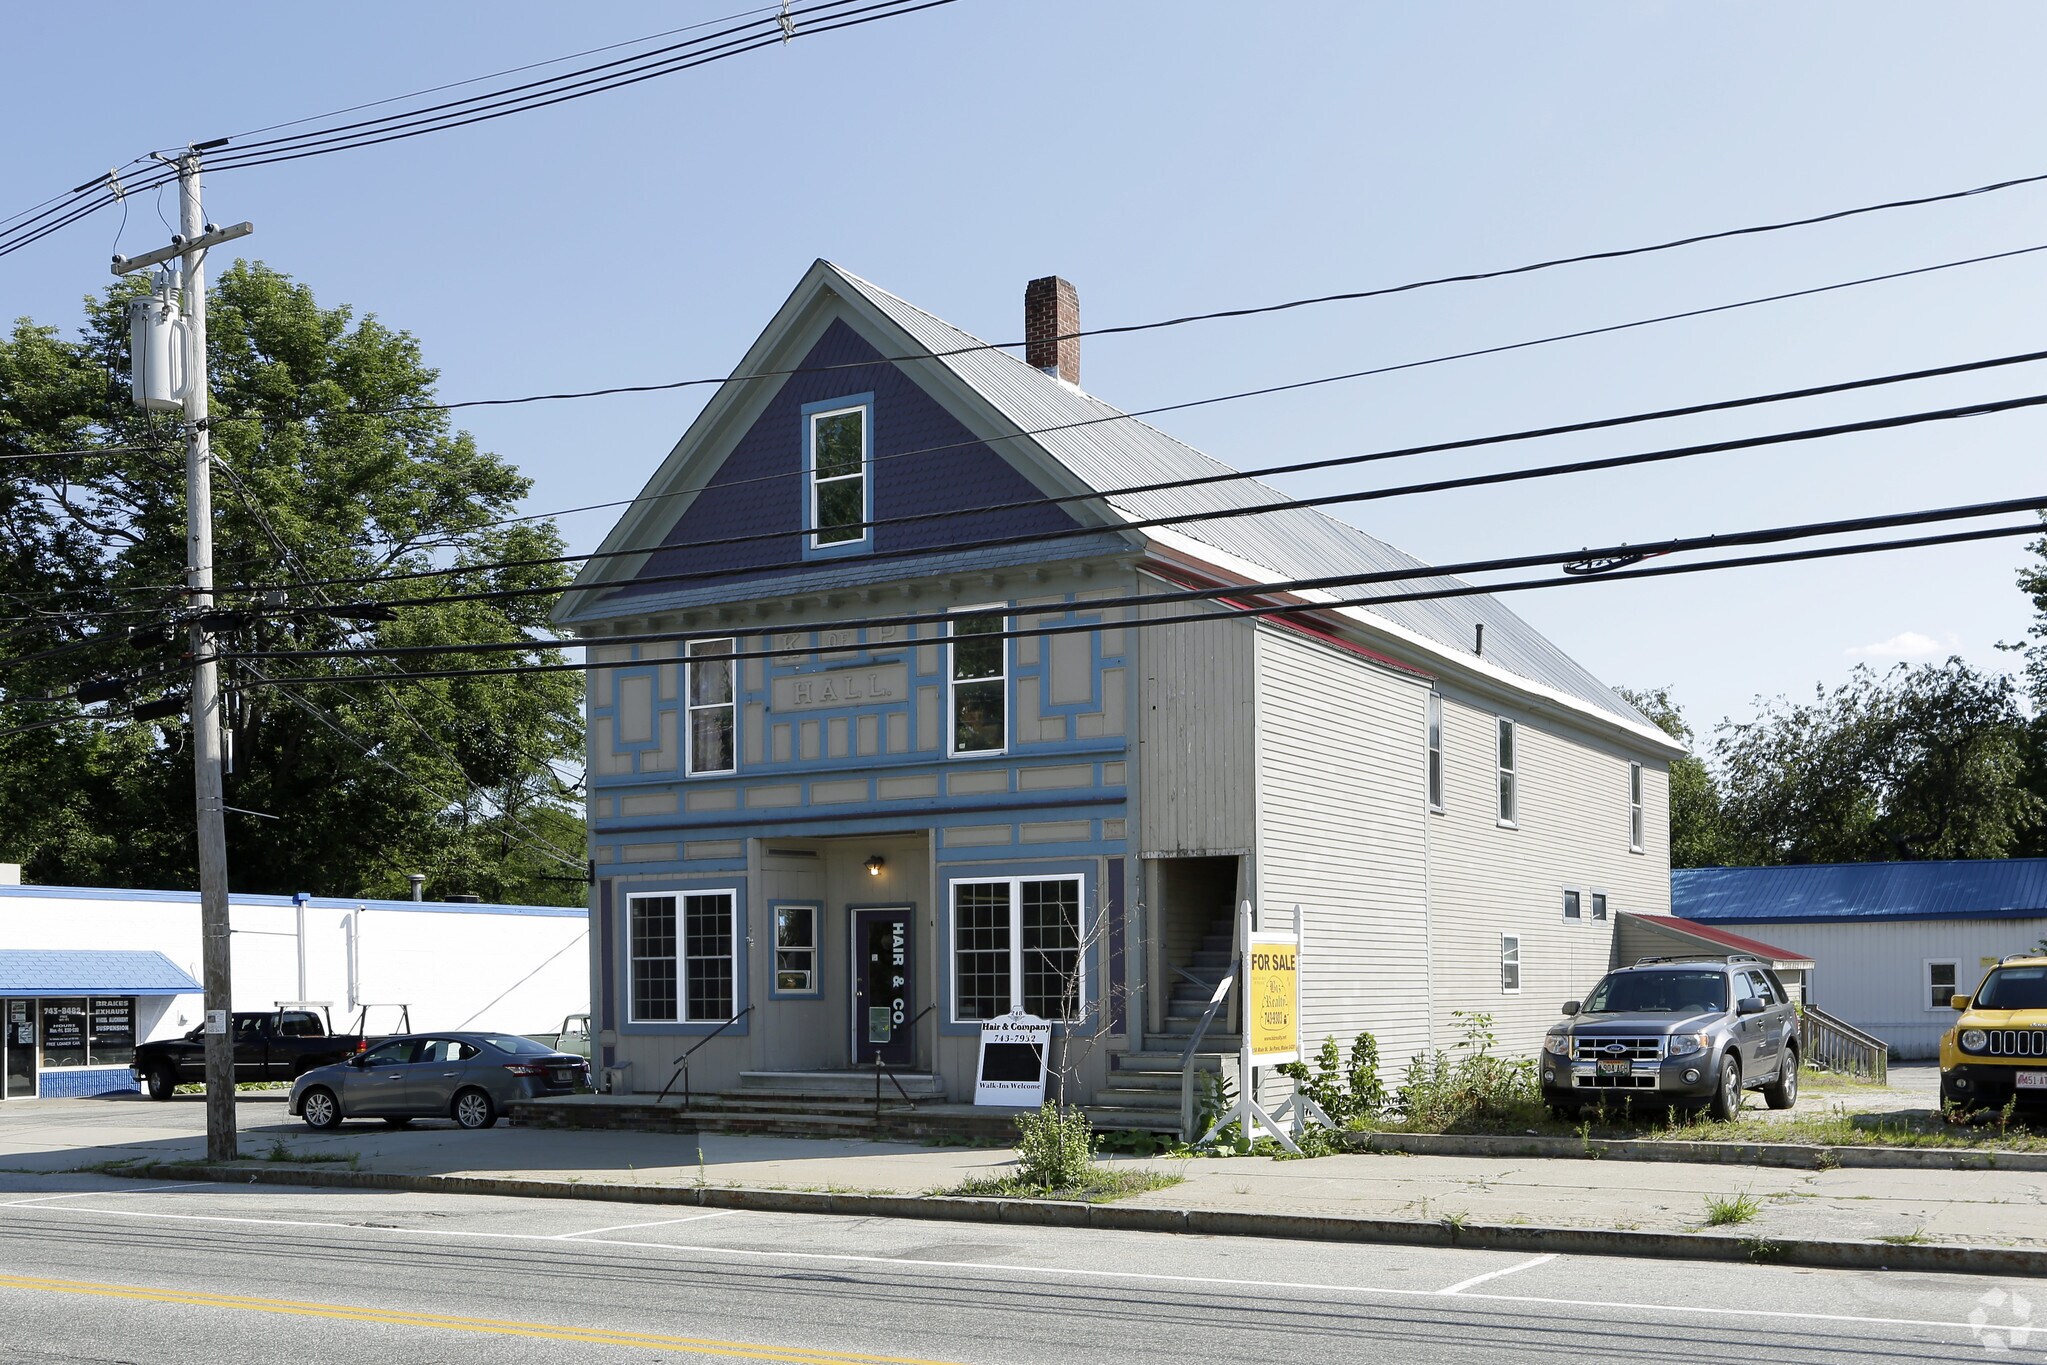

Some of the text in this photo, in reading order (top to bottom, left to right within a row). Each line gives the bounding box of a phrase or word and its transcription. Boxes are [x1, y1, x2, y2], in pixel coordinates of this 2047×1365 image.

[1252, 953, 1296, 971] FOR SALE
[893, 922, 904, 1029] HAIR & CO.
[982, 1023, 1050, 1033] Hair & Company
